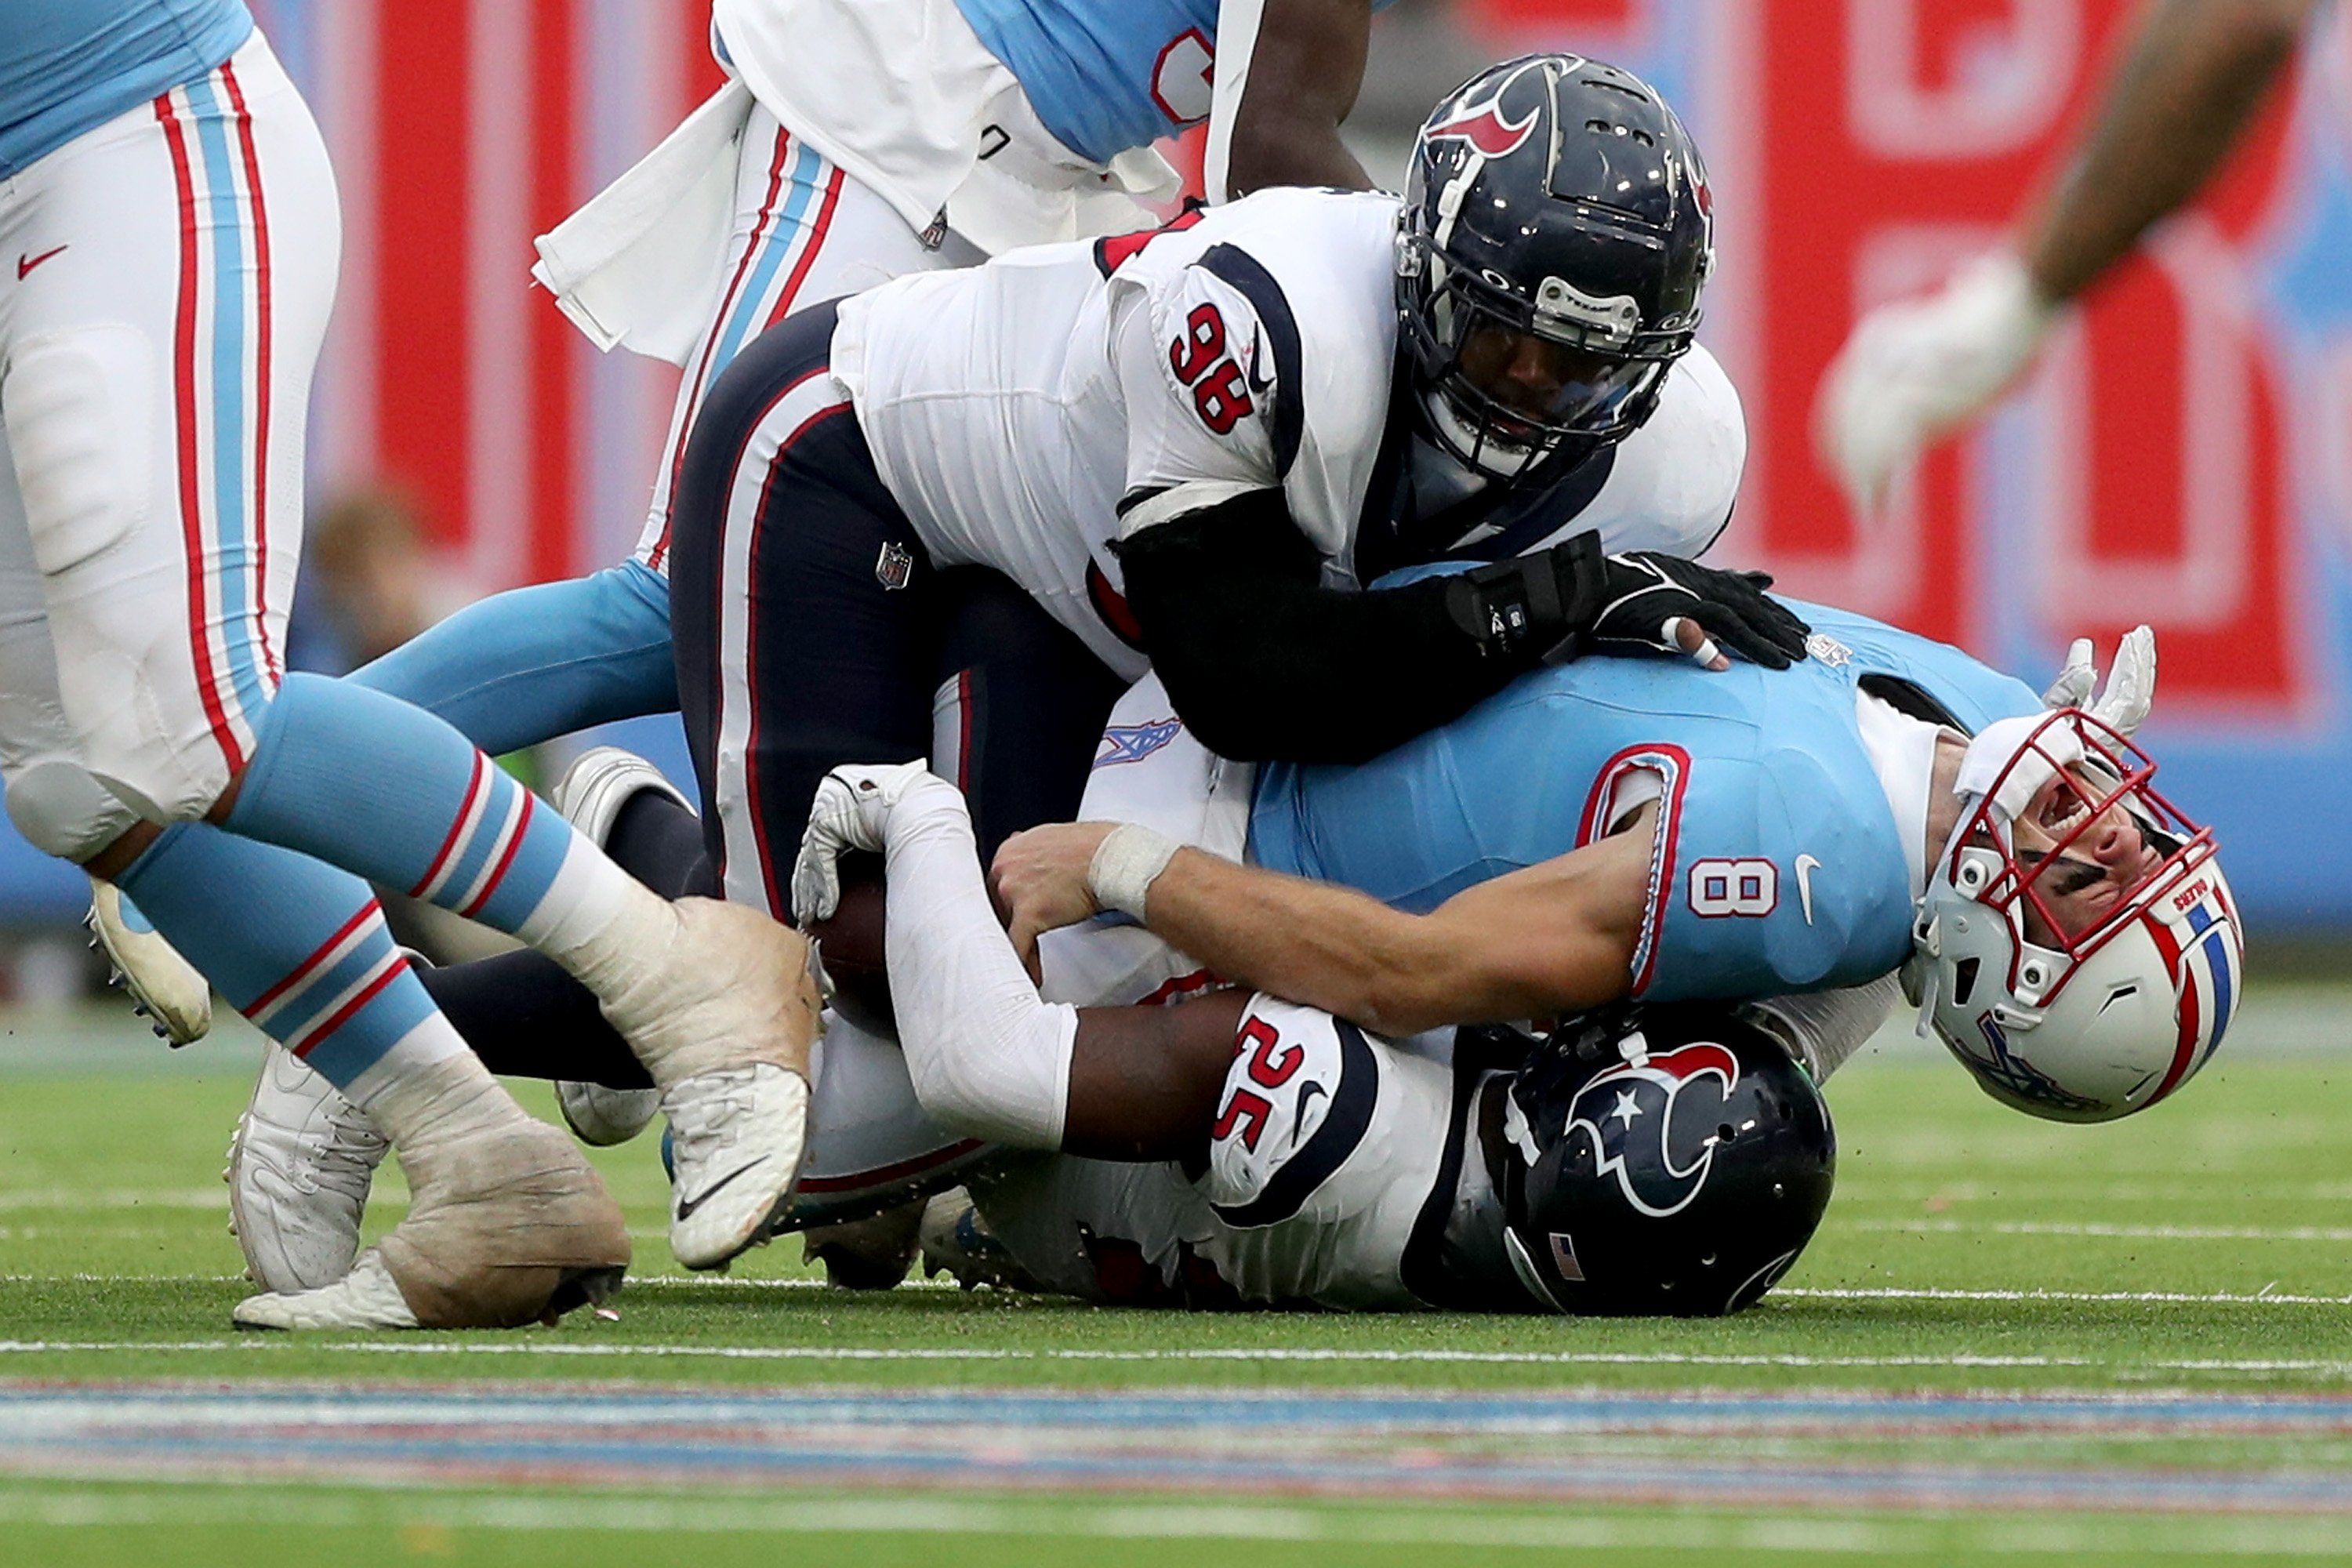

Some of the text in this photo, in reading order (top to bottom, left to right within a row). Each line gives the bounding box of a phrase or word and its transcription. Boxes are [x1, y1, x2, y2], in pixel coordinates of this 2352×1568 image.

[1169, 301, 1254, 435] 98
[1687, 858, 1778, 918] 8
[1212, 1013, 1305, 1155] 25
